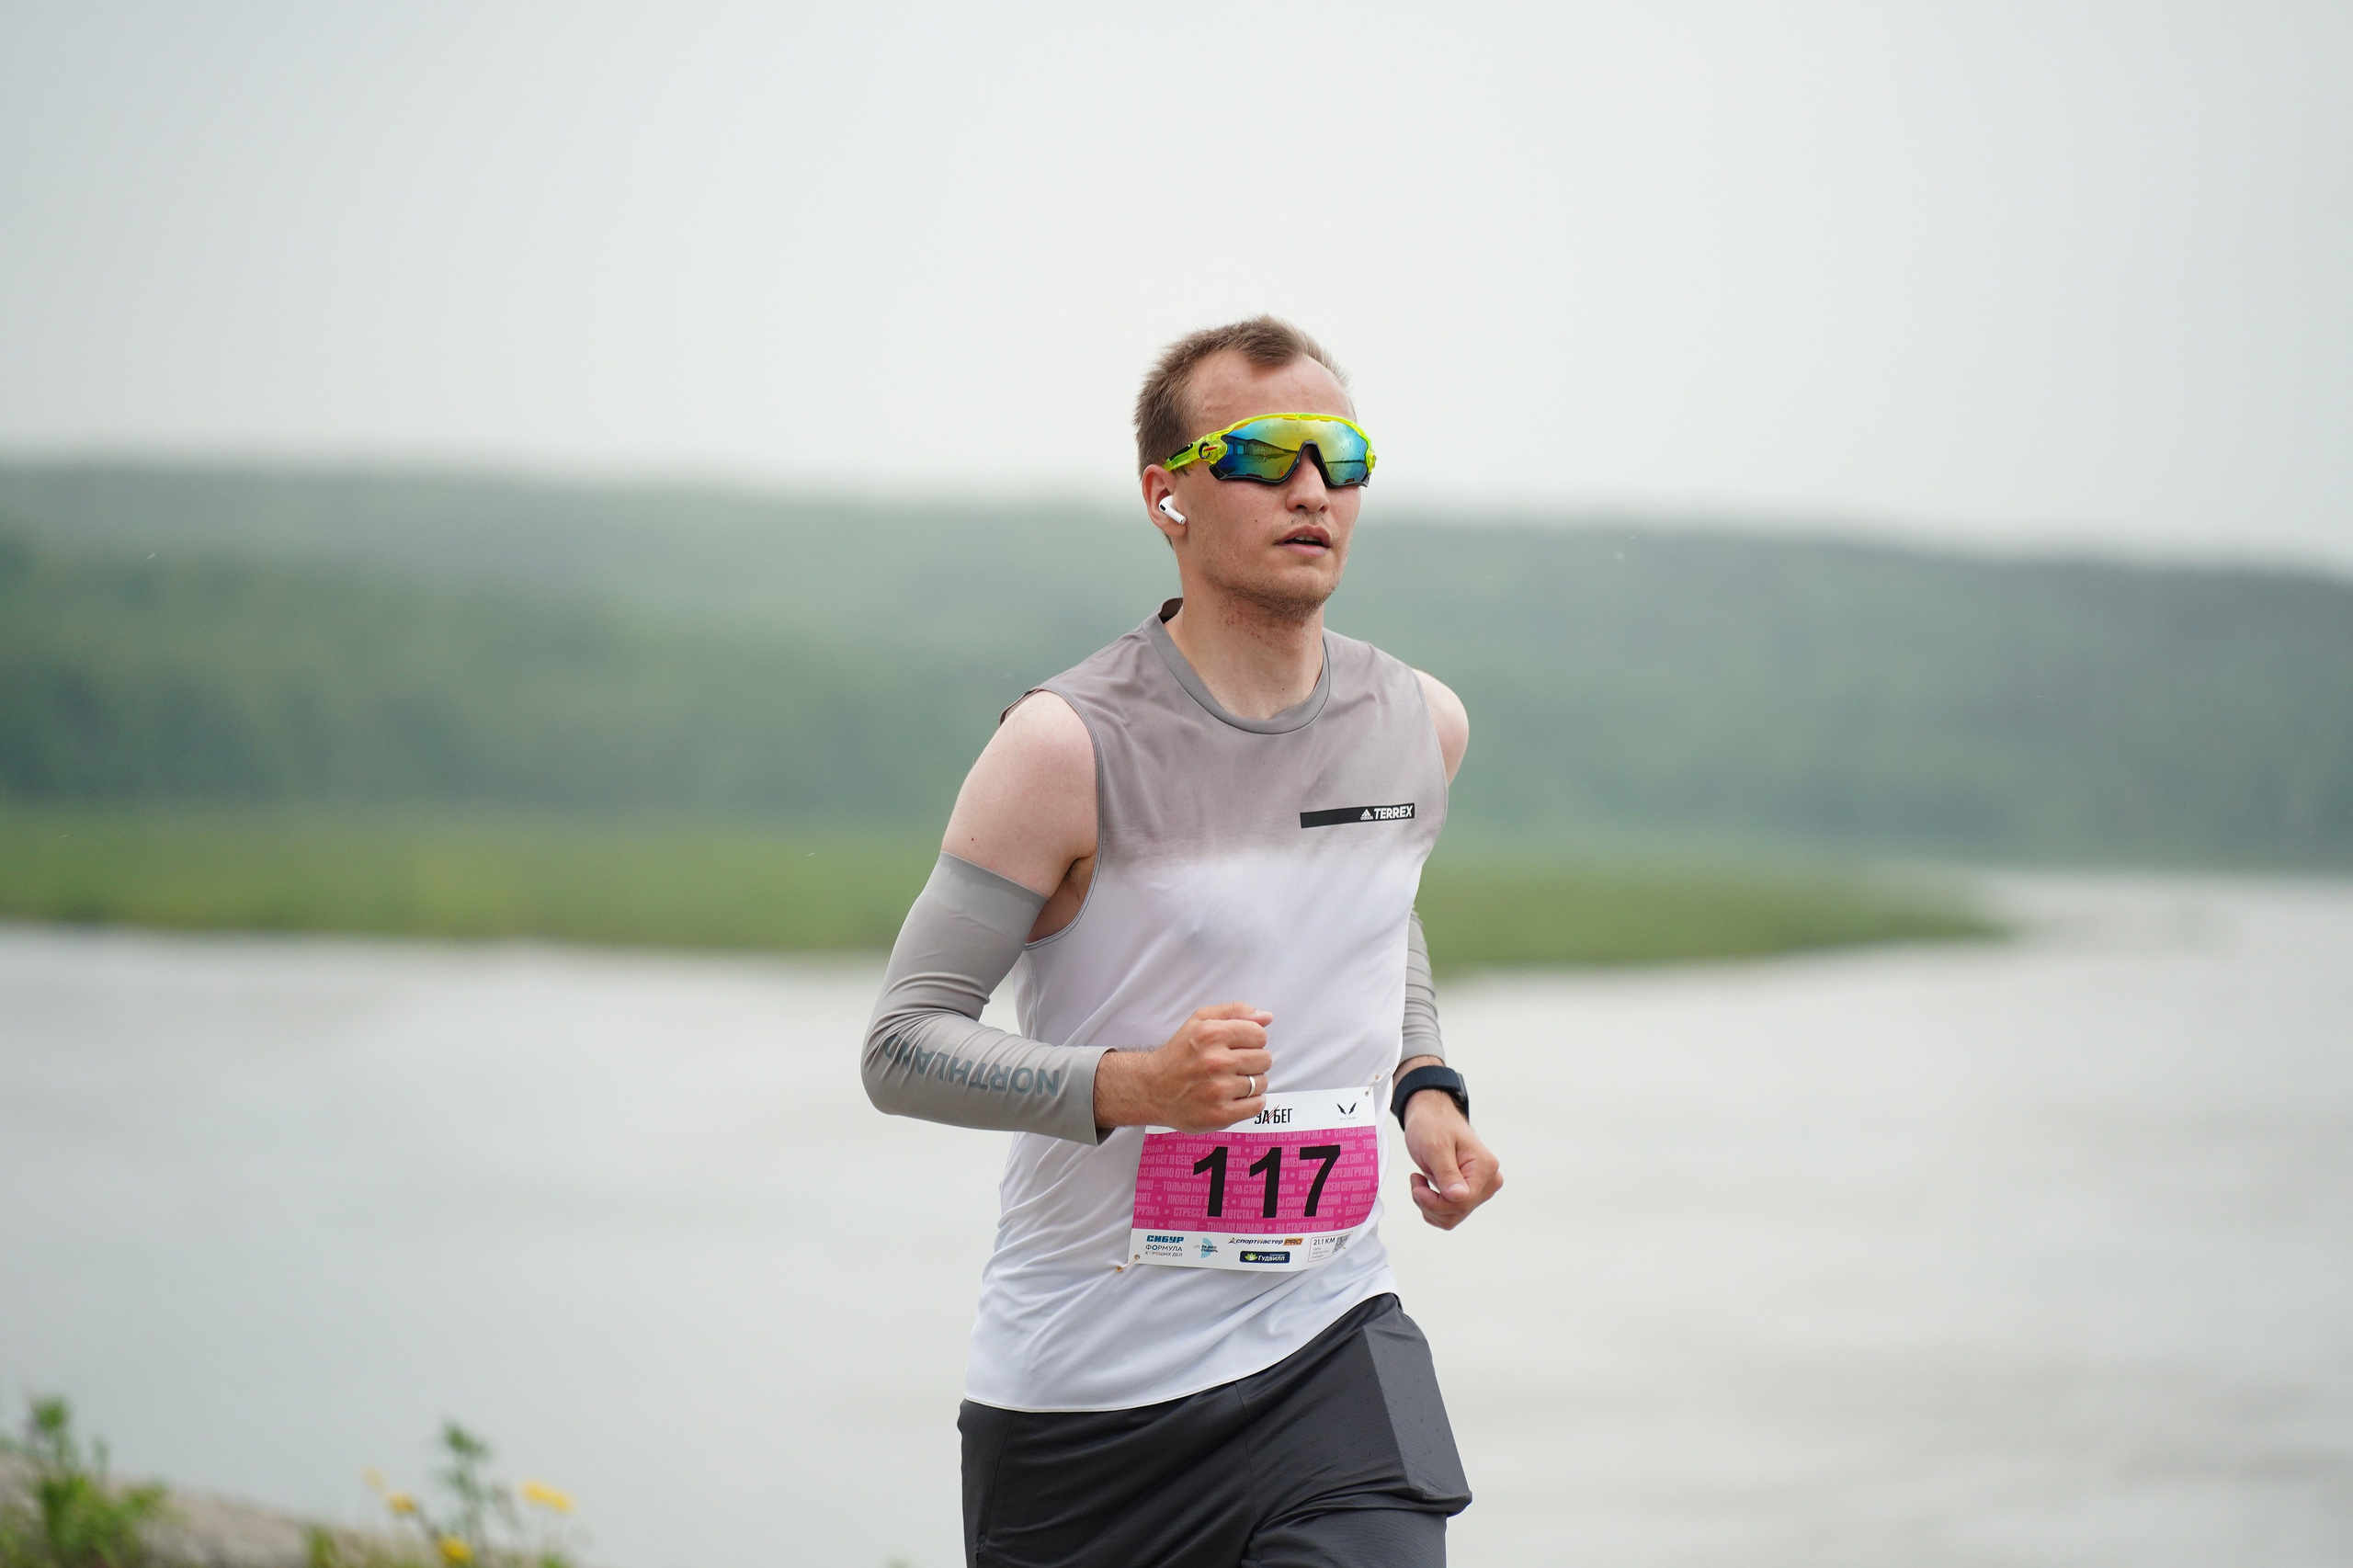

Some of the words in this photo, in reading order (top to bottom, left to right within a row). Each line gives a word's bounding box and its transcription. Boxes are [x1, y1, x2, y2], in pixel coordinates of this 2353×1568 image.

[1374, 805, 1413, 820] TERREX
[883, 1034, 1061, 1097] NORTHLAND
[1176, 1156, 1194, 1165] СЕБЕ
[1163, 1181, 1192, 1192] ТОЛЬКО
[1193, 1145, 1341, 1219] 117
[1167, 1195, 1189, 1205] ЛЮБИ
[1173, 1208, 1201, 1218] СТРЕСС
[1168, 1220, 1198, 1231] ФИНИШ
[1236, 1222, 1265, 1233] НАЧАЛО
[1146, 1235, 1184, 1244] СИБУР
[1145, 1244, 1183, 1252] ФОРМУЛА
